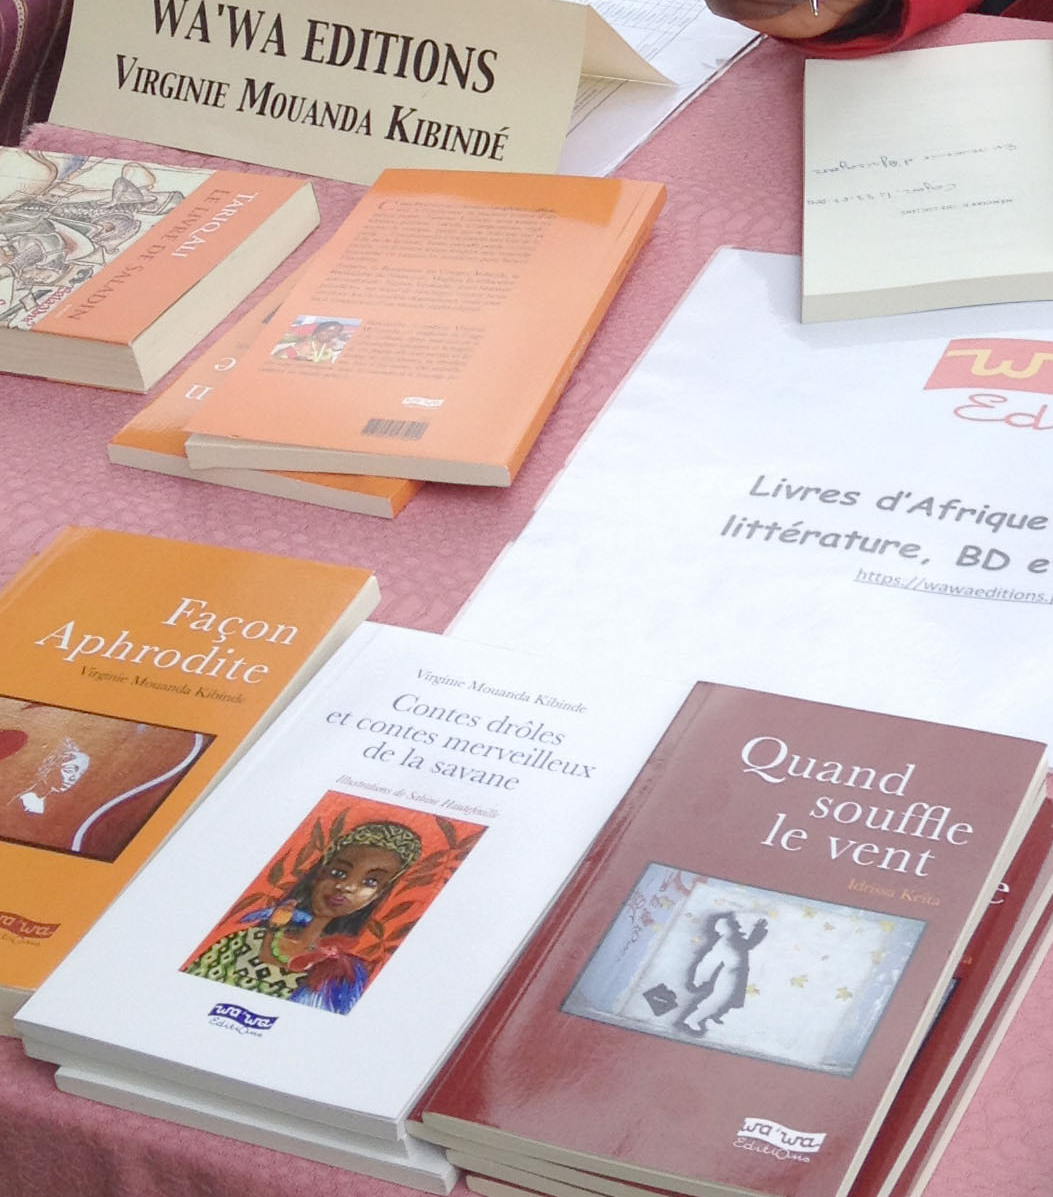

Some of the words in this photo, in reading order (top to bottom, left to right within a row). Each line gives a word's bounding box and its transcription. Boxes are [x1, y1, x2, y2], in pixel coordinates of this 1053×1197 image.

[302, 19, 499, 94] EDITIONS
[190, 192, 259, 237] TARIQ
[205, 189, 231, 204] LE
[160, 206, 209, 240] LIVRE
[171, 234, 206, 258] ALI
[140, 244, 166, 262] DE
[67, 264, 144, 321] SALADIN
[749, 474, 861, 506] Livres
[876, 491, 1049, 533] d'Afrique
[720, 514, 931, 566] littérature,
[955, 545, 1011, 572] BD
[162, 597, 299, 645] Façon
[34, 620, 269, 685] Aphrodite
[79, 665, 129, 683] Virginie
[131, 675, 191, 696] Mouanda
[416, 668, 467, 688] Virginie
[467, 680, 531, 702] Mouanda
[534, 693, 589, 715] Kibinde
[326, 710, 353, 726] et
[356, 716, 439, 745] contes
[442, 735, 598, 779] merveilleux
[392, 693, 481, 728] Contes
[486, 715, 566, 747] drôles
[363, 741, 395, 763] de
[400, 748, 424, 770] la
[431, 759, 520, 791] savane
[741, 736, 916, 797] Quand
[760, 813, 808, 852] le
[828, 836, 936, 877] vent
[809, 796, 973, 845] souffle
